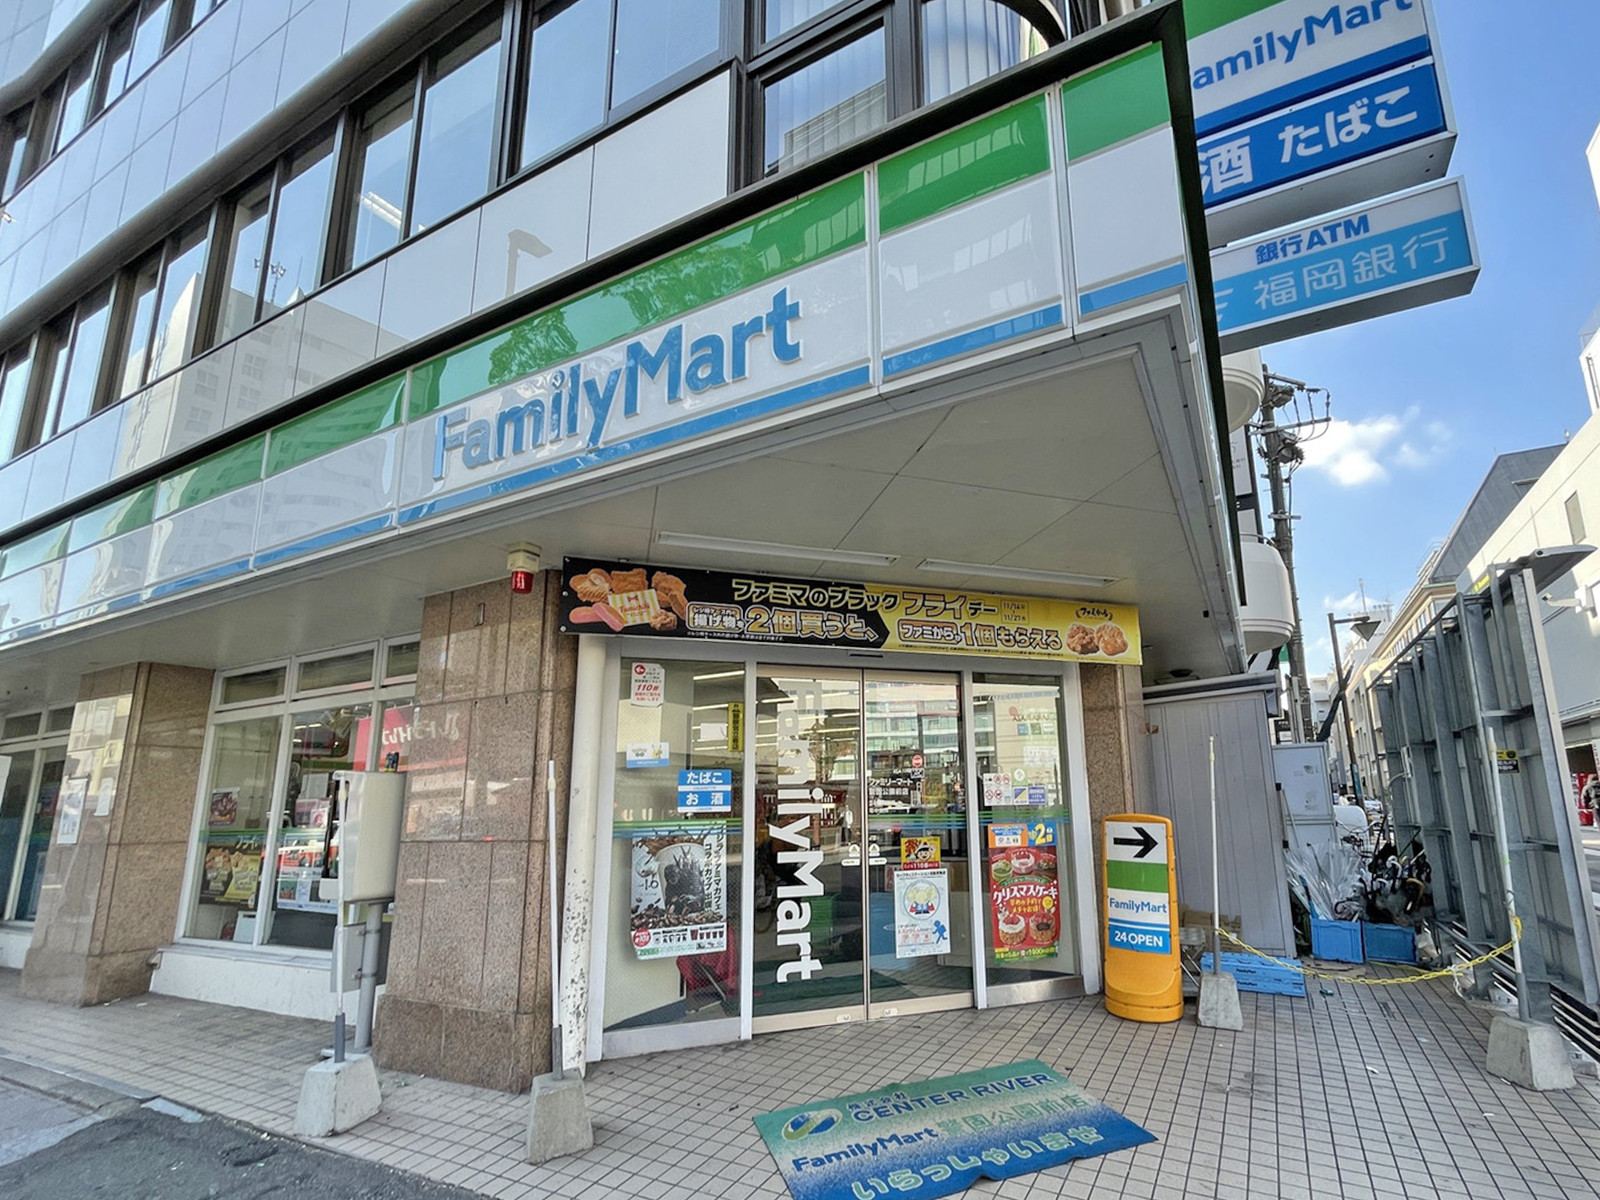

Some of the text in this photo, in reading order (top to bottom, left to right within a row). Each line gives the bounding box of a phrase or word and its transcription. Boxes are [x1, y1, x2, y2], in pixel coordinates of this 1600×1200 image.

[1193, 0, 1412, 89] amilyMar
[1198, 86, 1417, 194] 酒 たばこ
[1255, 214, 1370, 265] 銀行ATM
[1254, 227, 1449, 310] 福岡銀行
[432, 286, 802, 481] FamilyMart
[686, 772, 723, 784] たばこ
[769, 680, 824, 983] FamilyMart
[993, 884, 1058, 905] クリスマスケーキ
[1109, 897, 1168, 913] FamilyMart
[1128, 932, 1163, 947] OPEN
[853, 1072, 1053, 1122] CENTER RIVER
[791, 1127, 939, 1173] FamilyMart
[851, 1125, 1105, 1199] いらっしゃいませ
